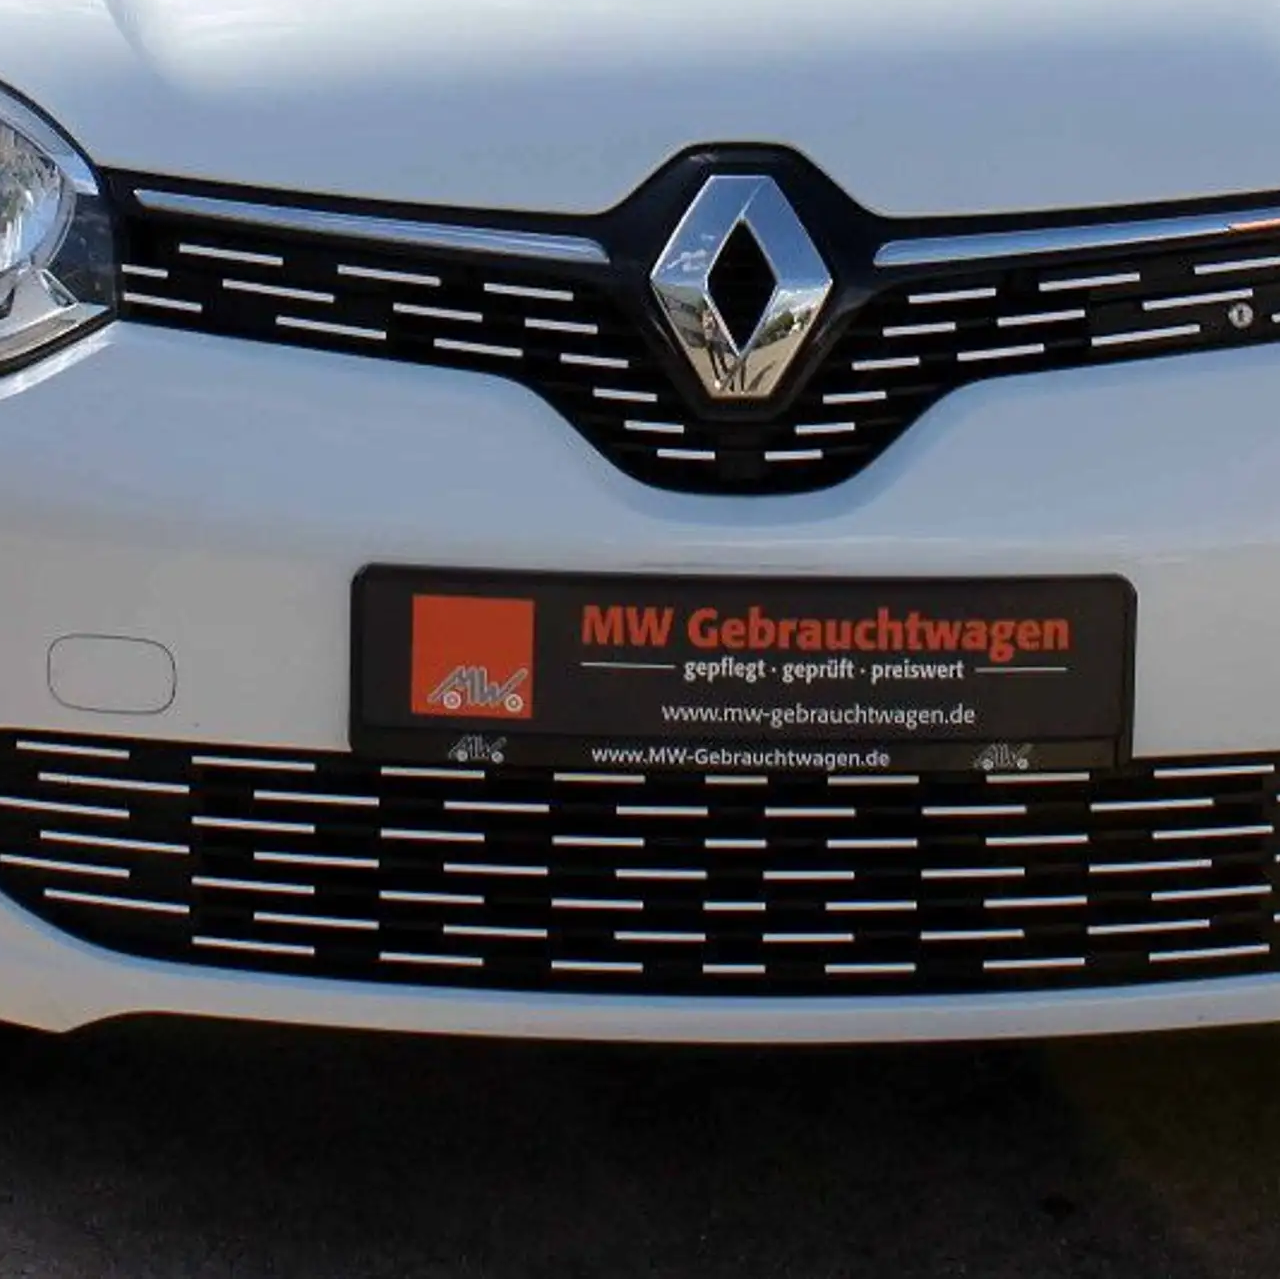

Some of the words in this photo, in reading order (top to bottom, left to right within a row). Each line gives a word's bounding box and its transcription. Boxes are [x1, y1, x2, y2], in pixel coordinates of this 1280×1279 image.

[581, 604, 675, 648] MW
[687, 605, 1069, 663] Gebrauchtwagen
[683, 657, 767, 683] gepflegt
[781, 658, 856, 684] geprüft
[871, 659, 965, 685] preiswert
[661, 701, 976, 731] www.mw-gebrauchtwagen.de
[591, 746, 891, 772] www.MW-Gebrauchtwagen.de
